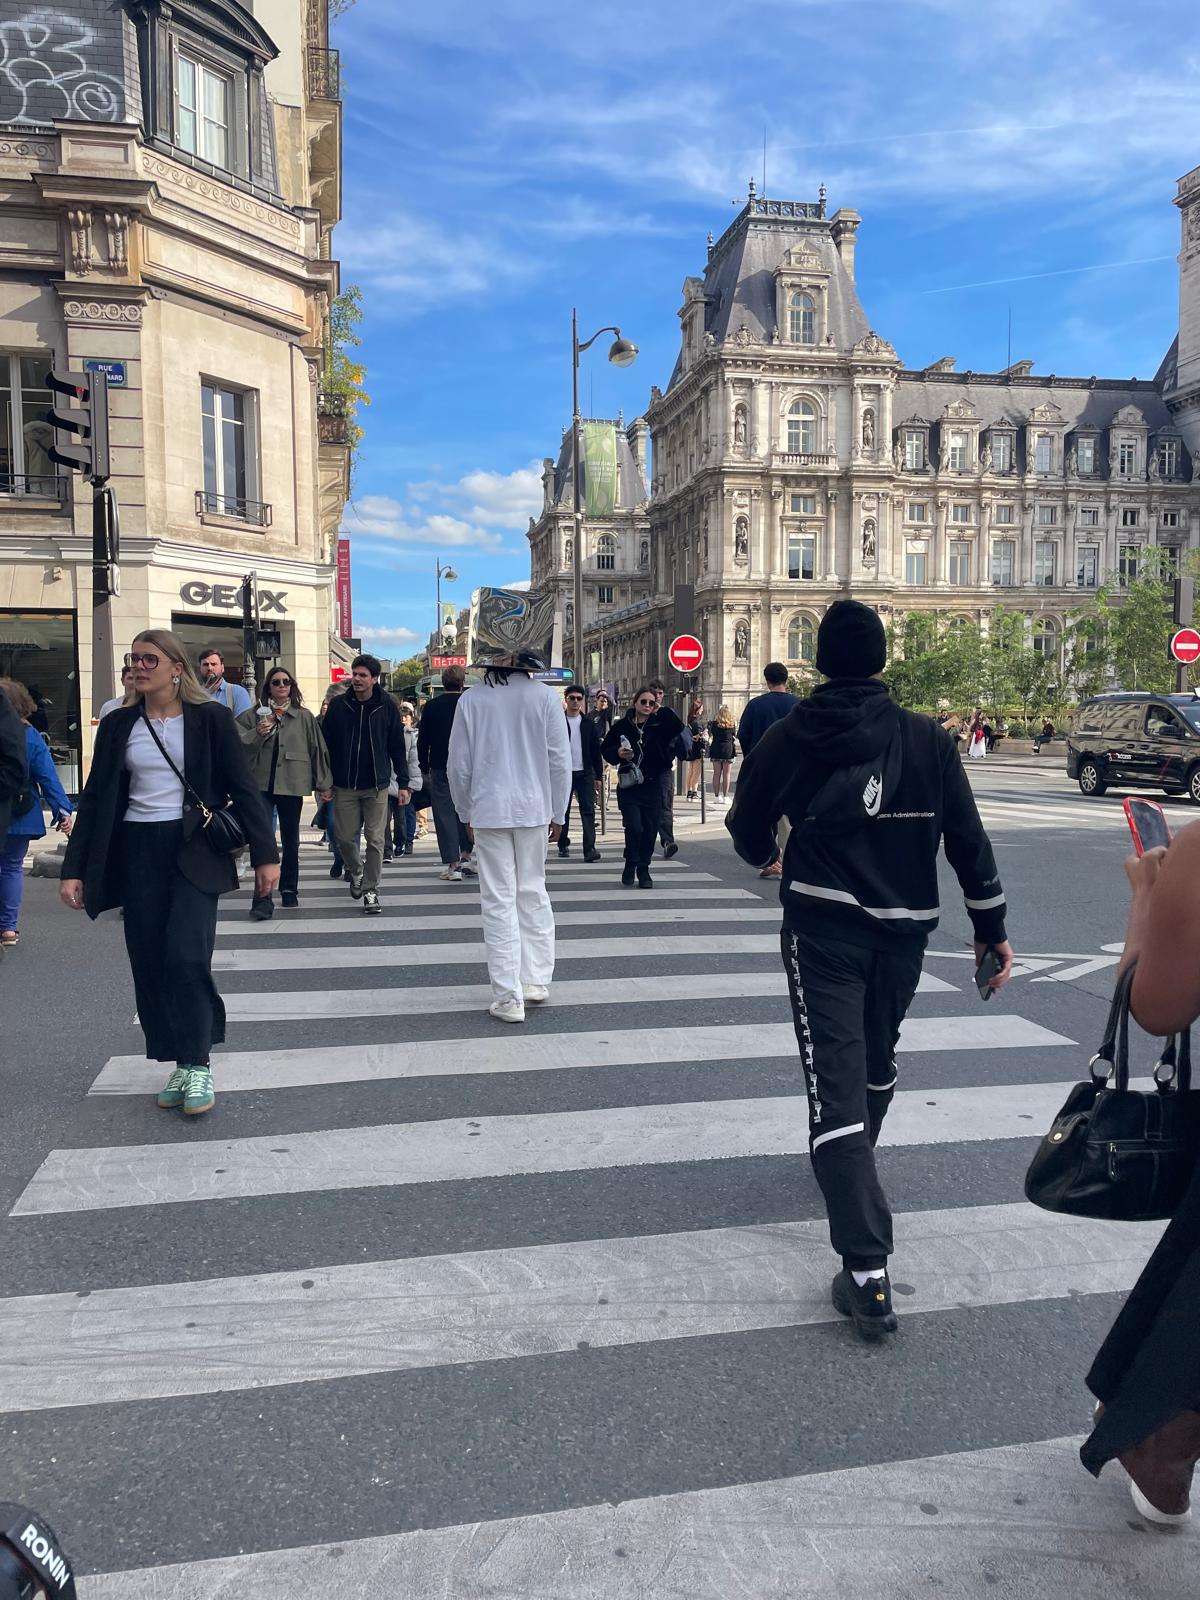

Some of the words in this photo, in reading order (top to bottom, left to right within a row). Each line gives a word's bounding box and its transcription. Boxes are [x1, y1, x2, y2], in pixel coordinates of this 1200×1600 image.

[98, 364, 113, 372] RUE
[180, 581, 289, 614] GEOX
[863, 775, 881, 808] NIKE
[893, 811, 936, 819] Administration
[20, 1523, 70, 1590] RONIN
